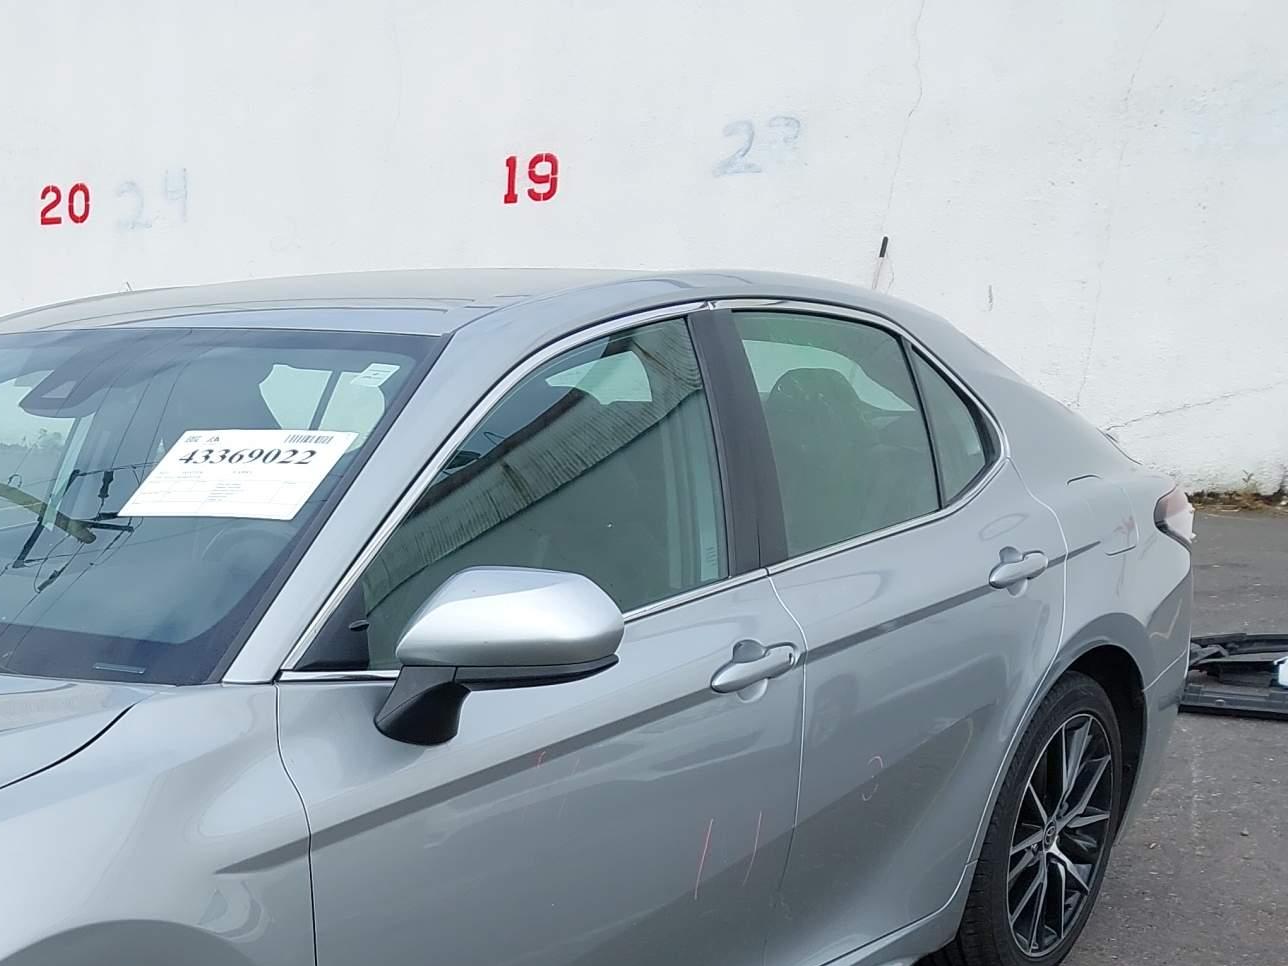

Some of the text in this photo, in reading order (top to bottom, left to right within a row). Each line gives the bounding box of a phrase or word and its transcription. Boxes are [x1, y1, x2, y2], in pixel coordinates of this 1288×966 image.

[502, 152, 560, 206] 19
[39, 182, 91, 226] 20
[178, 447, 318, 465] 43369022
